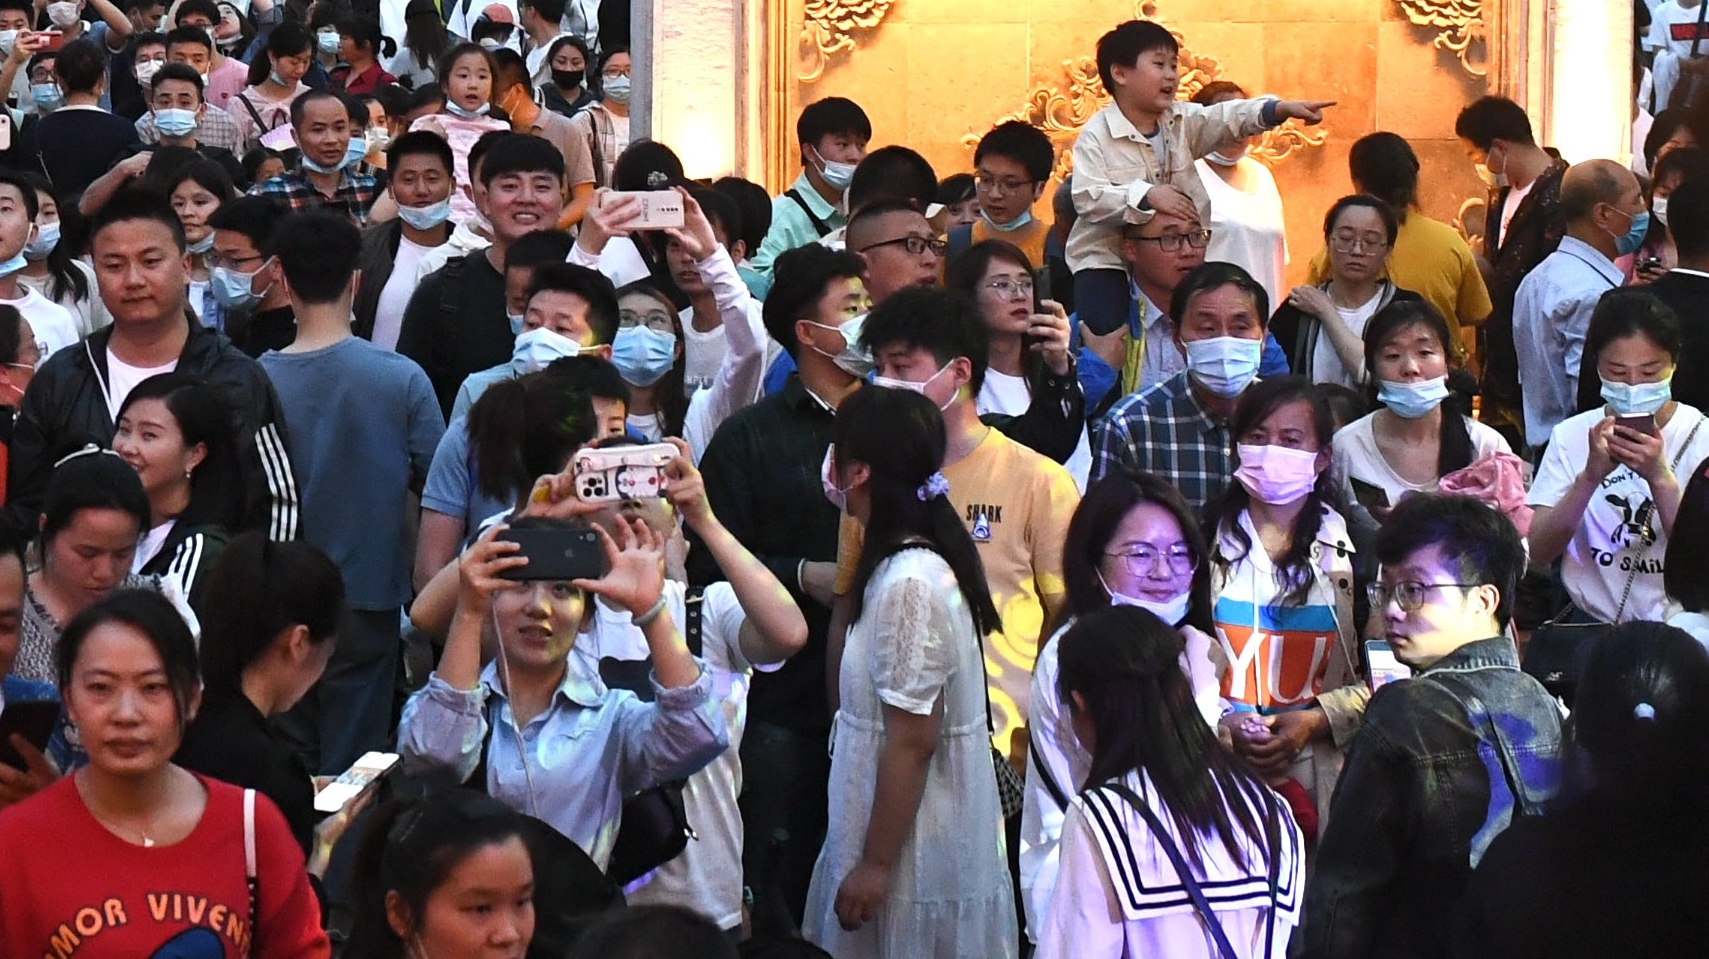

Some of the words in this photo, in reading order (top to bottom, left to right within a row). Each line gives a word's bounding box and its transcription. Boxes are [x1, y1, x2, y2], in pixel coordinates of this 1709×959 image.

[966, 504, 1002, 523] SHARK
[1591, 546, 1613, 567] TO
[44, 898, 127, 959] MOR
